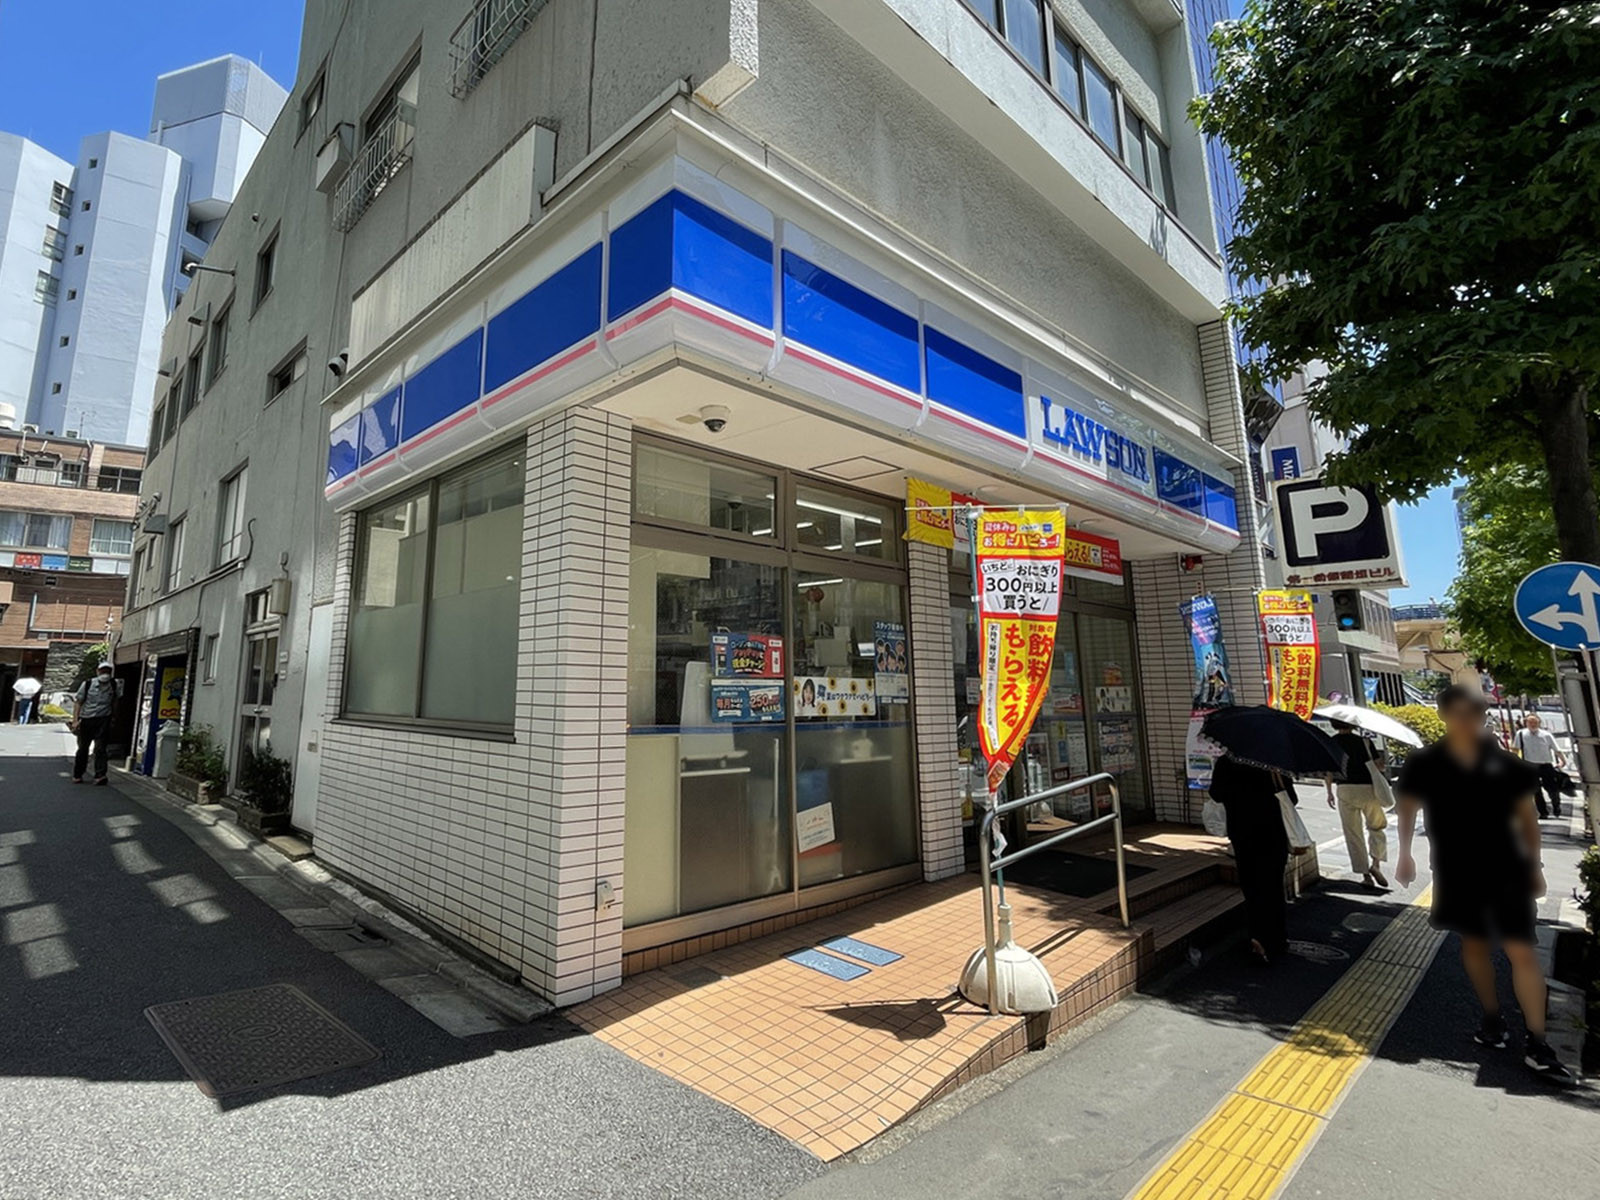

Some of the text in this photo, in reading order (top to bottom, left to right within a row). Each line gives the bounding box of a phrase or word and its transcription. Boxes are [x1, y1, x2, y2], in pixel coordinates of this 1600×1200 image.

[1040, 395, 1150, 483] LAWSON
[1288, 486, 1369, 558] P
[986, 577, 1058, 594] 300円以上
[1016, 562, 1058, 577] おにぎり
[1003, 594, 1041, 611] 買うと
[1001, 623, 1026, 728] もらえる
[1294, 653, 1312, 717] 飲料無料券
